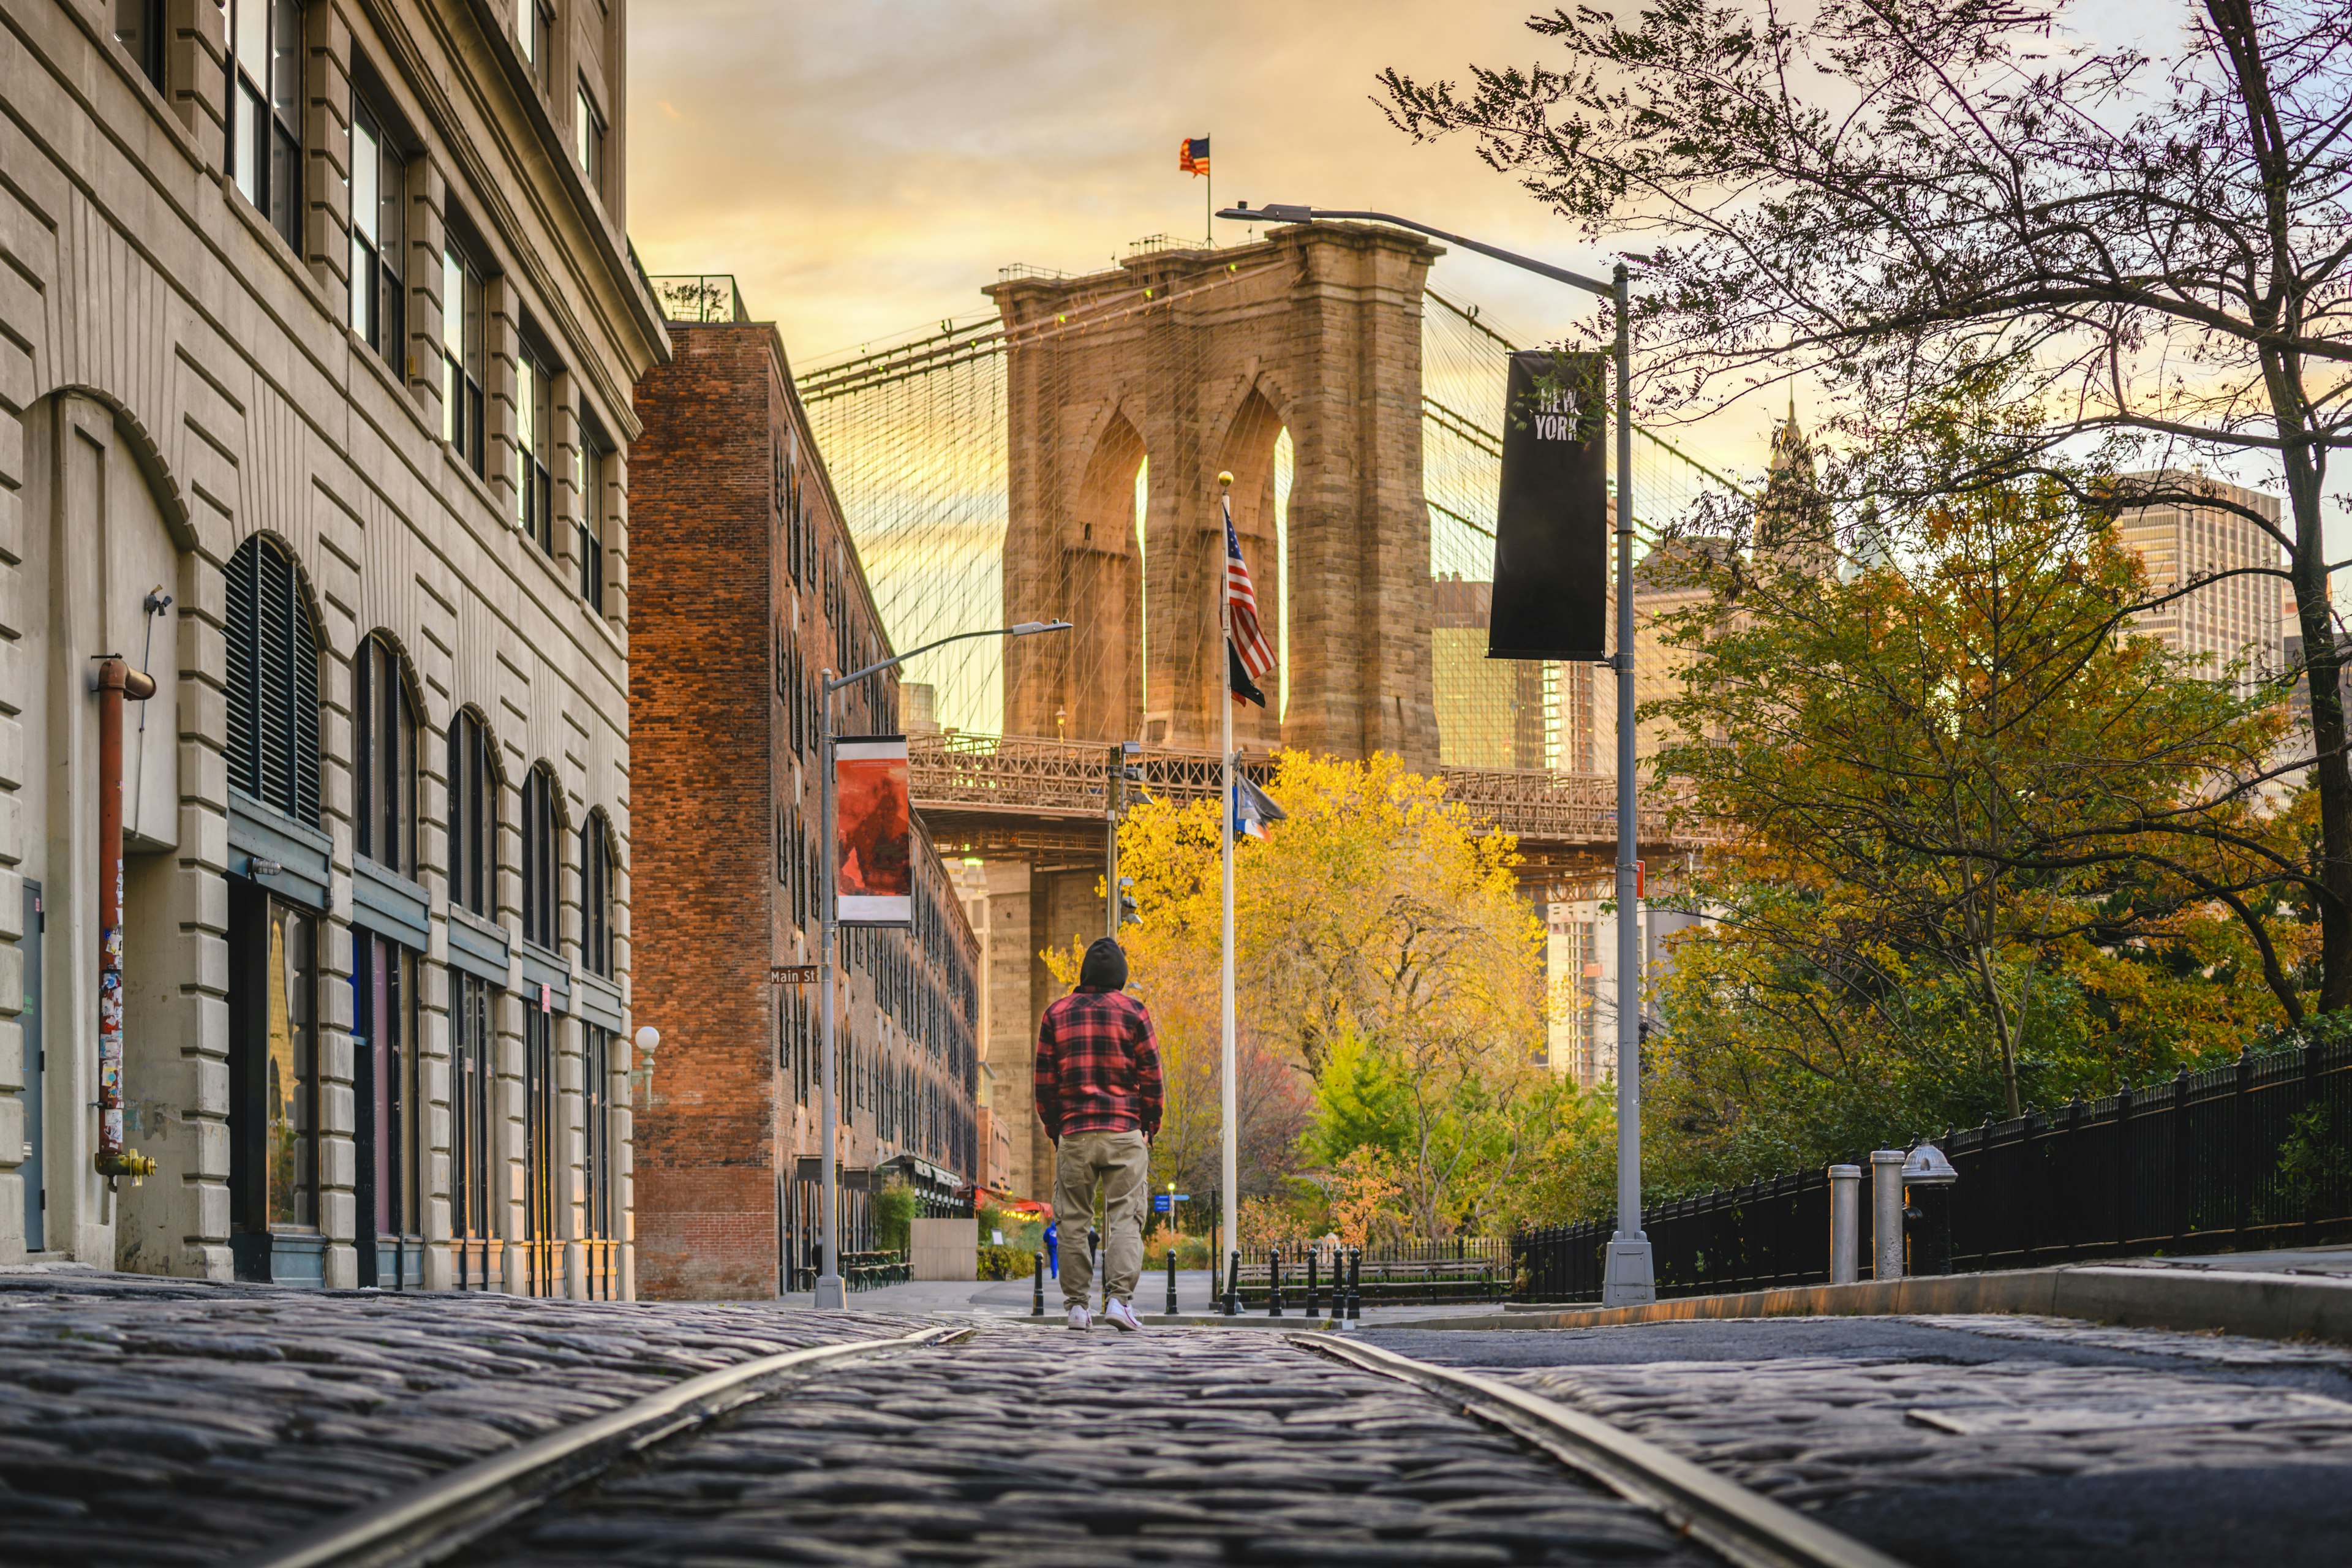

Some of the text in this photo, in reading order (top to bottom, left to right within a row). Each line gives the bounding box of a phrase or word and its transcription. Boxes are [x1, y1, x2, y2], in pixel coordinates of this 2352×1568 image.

[1534, 415, 1578, 441] YORK
[771, 970, 815, 983] Main St
